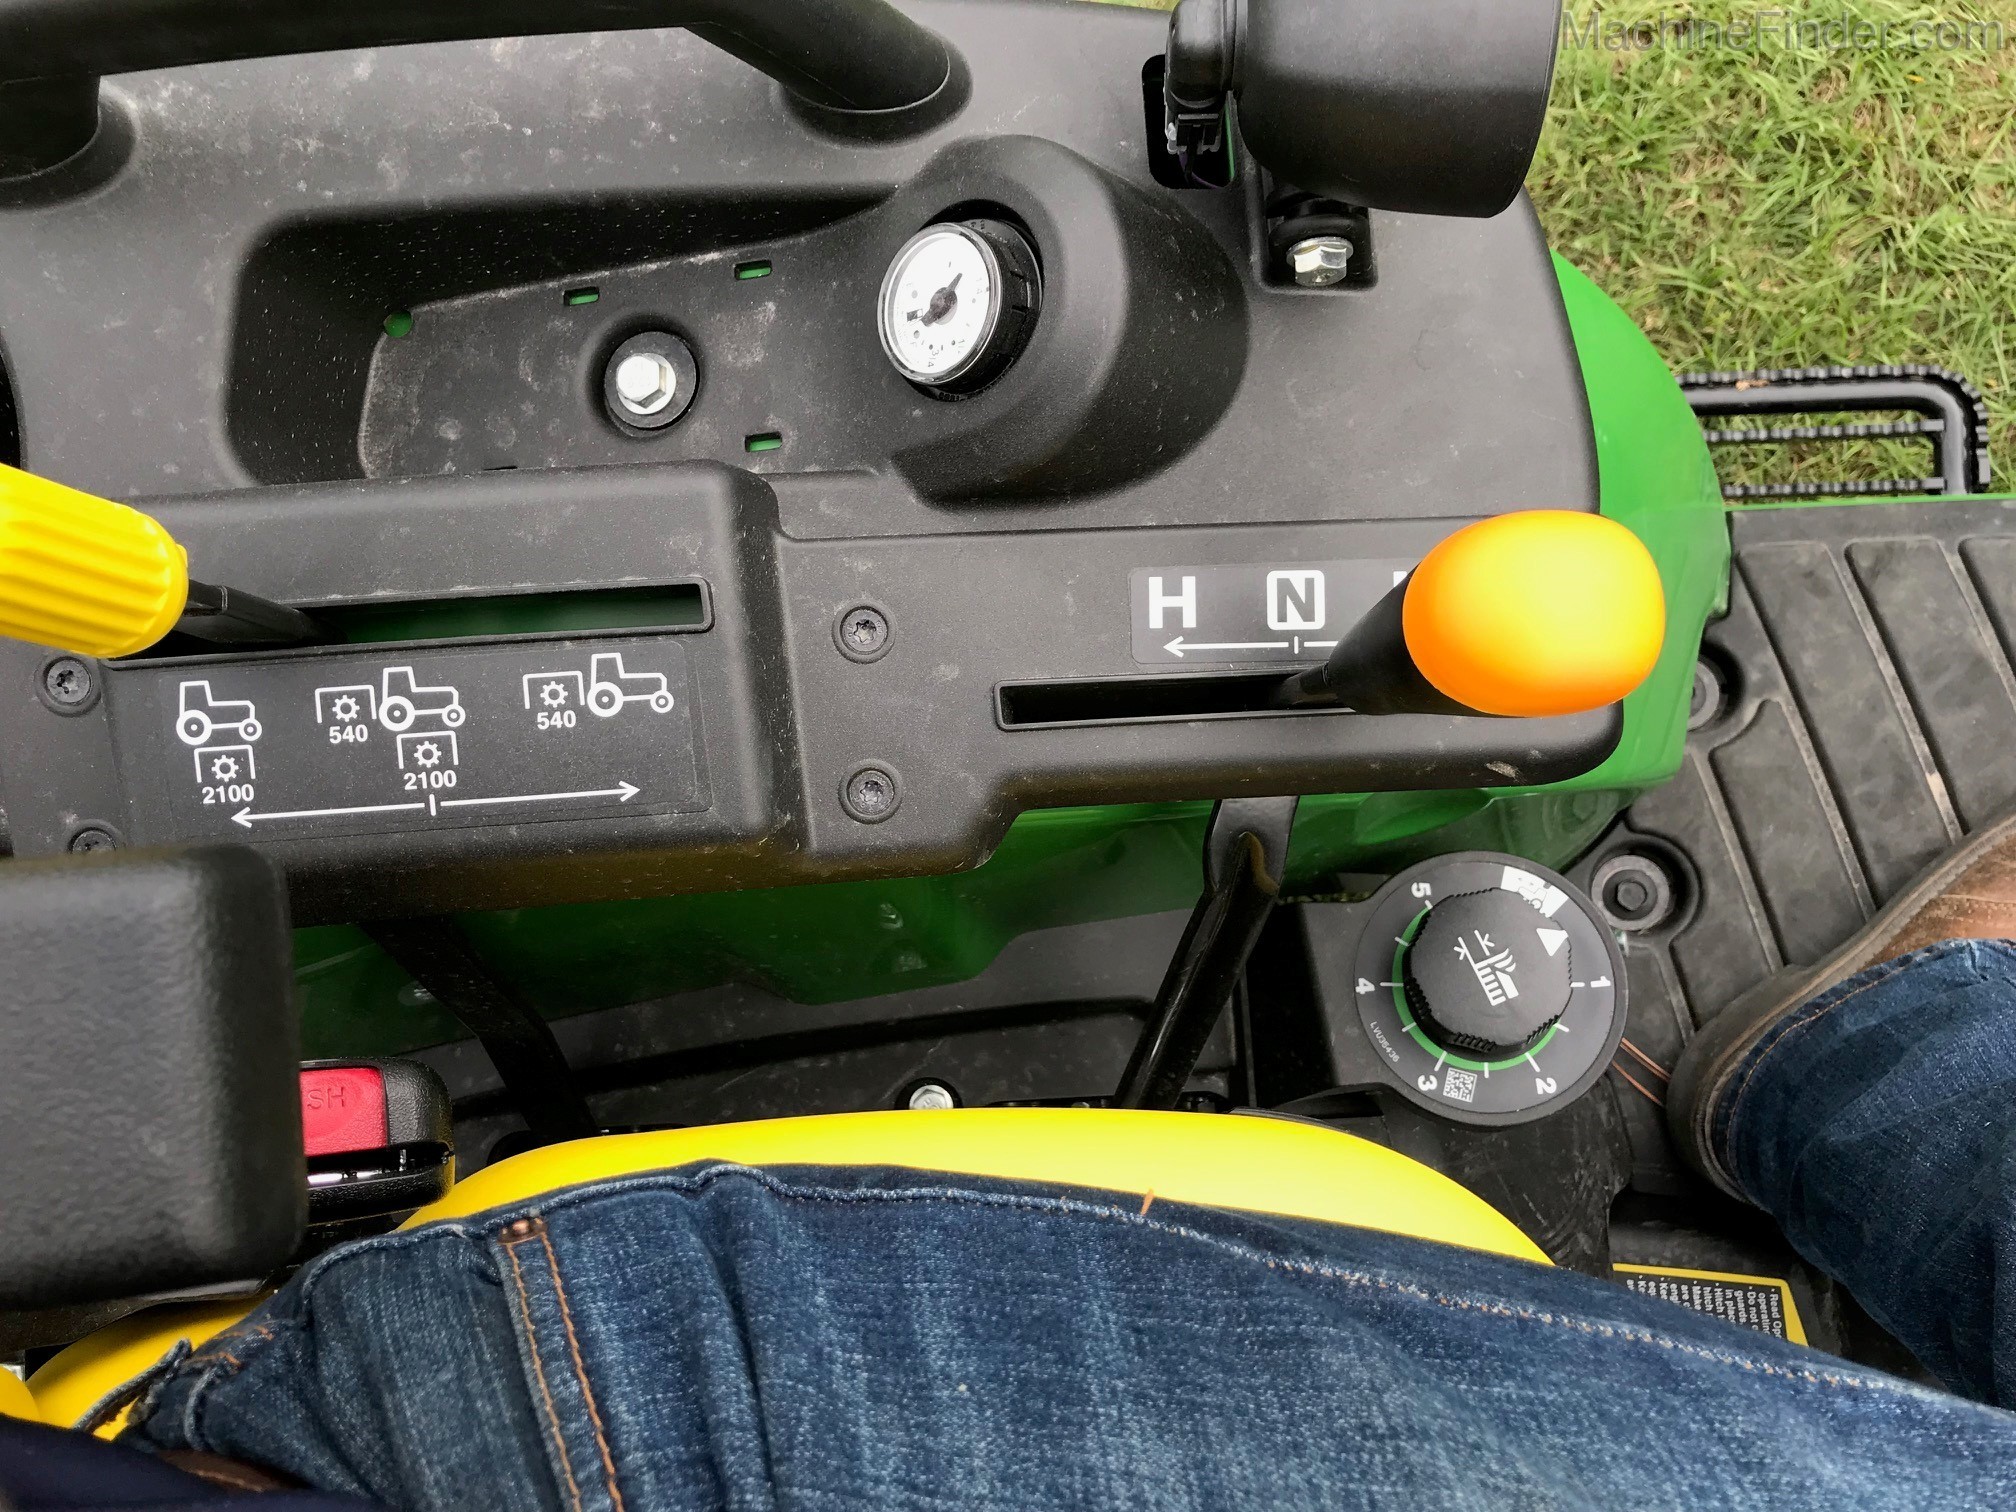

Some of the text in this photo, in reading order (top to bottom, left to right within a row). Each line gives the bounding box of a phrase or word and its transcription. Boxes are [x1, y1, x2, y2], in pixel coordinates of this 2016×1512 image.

[1148, 575, 1318, 629] H N
[536, 709, 577, 730] 540
[328, 723, 369, 745] 540
[403, 769, 458, 791] 2100
[201, 782, 255, 805] 2100
[1410, 882, 1432, 899] 5
[1355, 977, 1376, 995] 4
[1590, 975, 1612, 988] 1
[1417, 1074, 1438, 1092] 3
[1534, 1077, 1558, 1096] 2
[306, 1086, 346, 1110] SH
[1702, 1286, 1714, 1311] hitch
[1713, 1287, 1725, 1313] Hitch
[1746, 1291, 1757, 1306] Do
[1769, 1293, 1781, 1319] Read
[1748, 1306, 1759, 1323] not
